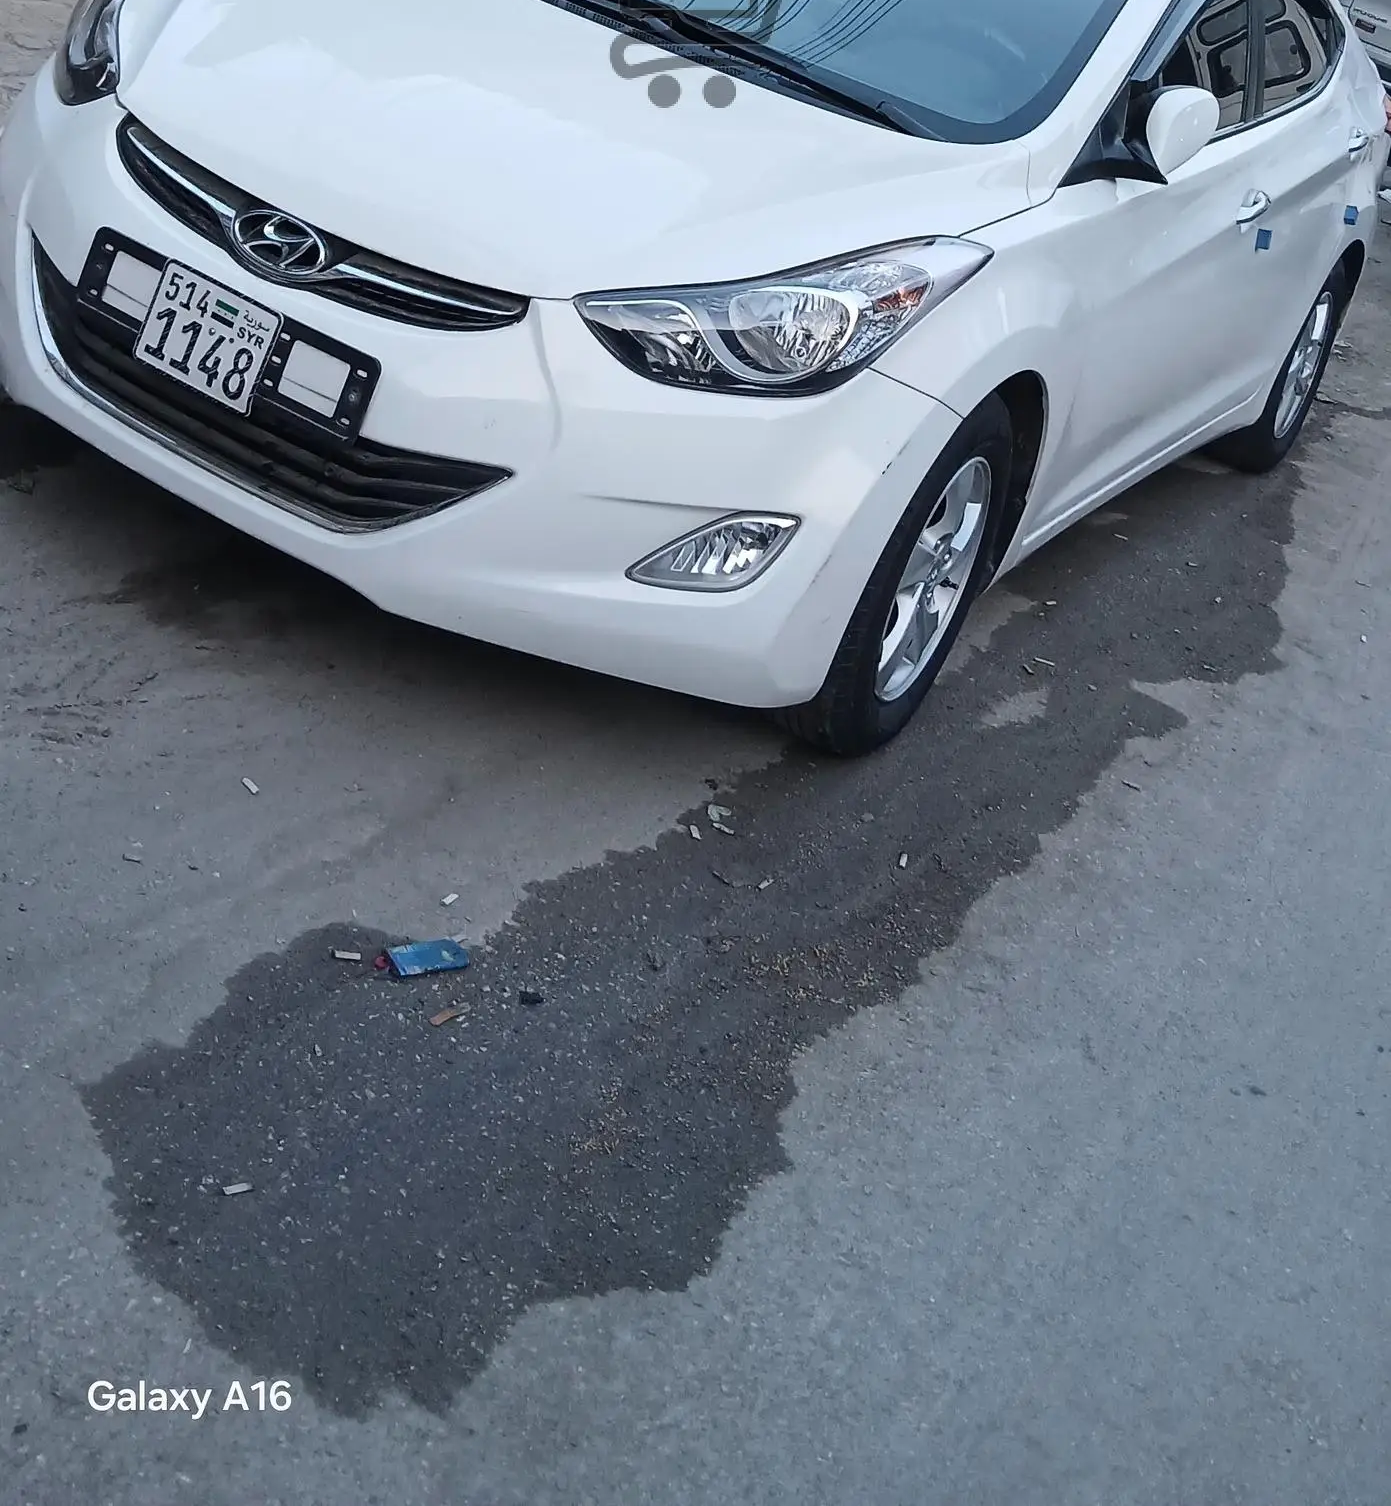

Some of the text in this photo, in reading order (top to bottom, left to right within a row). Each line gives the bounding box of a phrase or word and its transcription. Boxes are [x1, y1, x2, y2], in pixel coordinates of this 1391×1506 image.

[164, 272, 212, 319] 514
[236, 326, 265, 350] SYR
[242, 309, 271, 333] سورية
[144, 307, 254, 401] 1148
